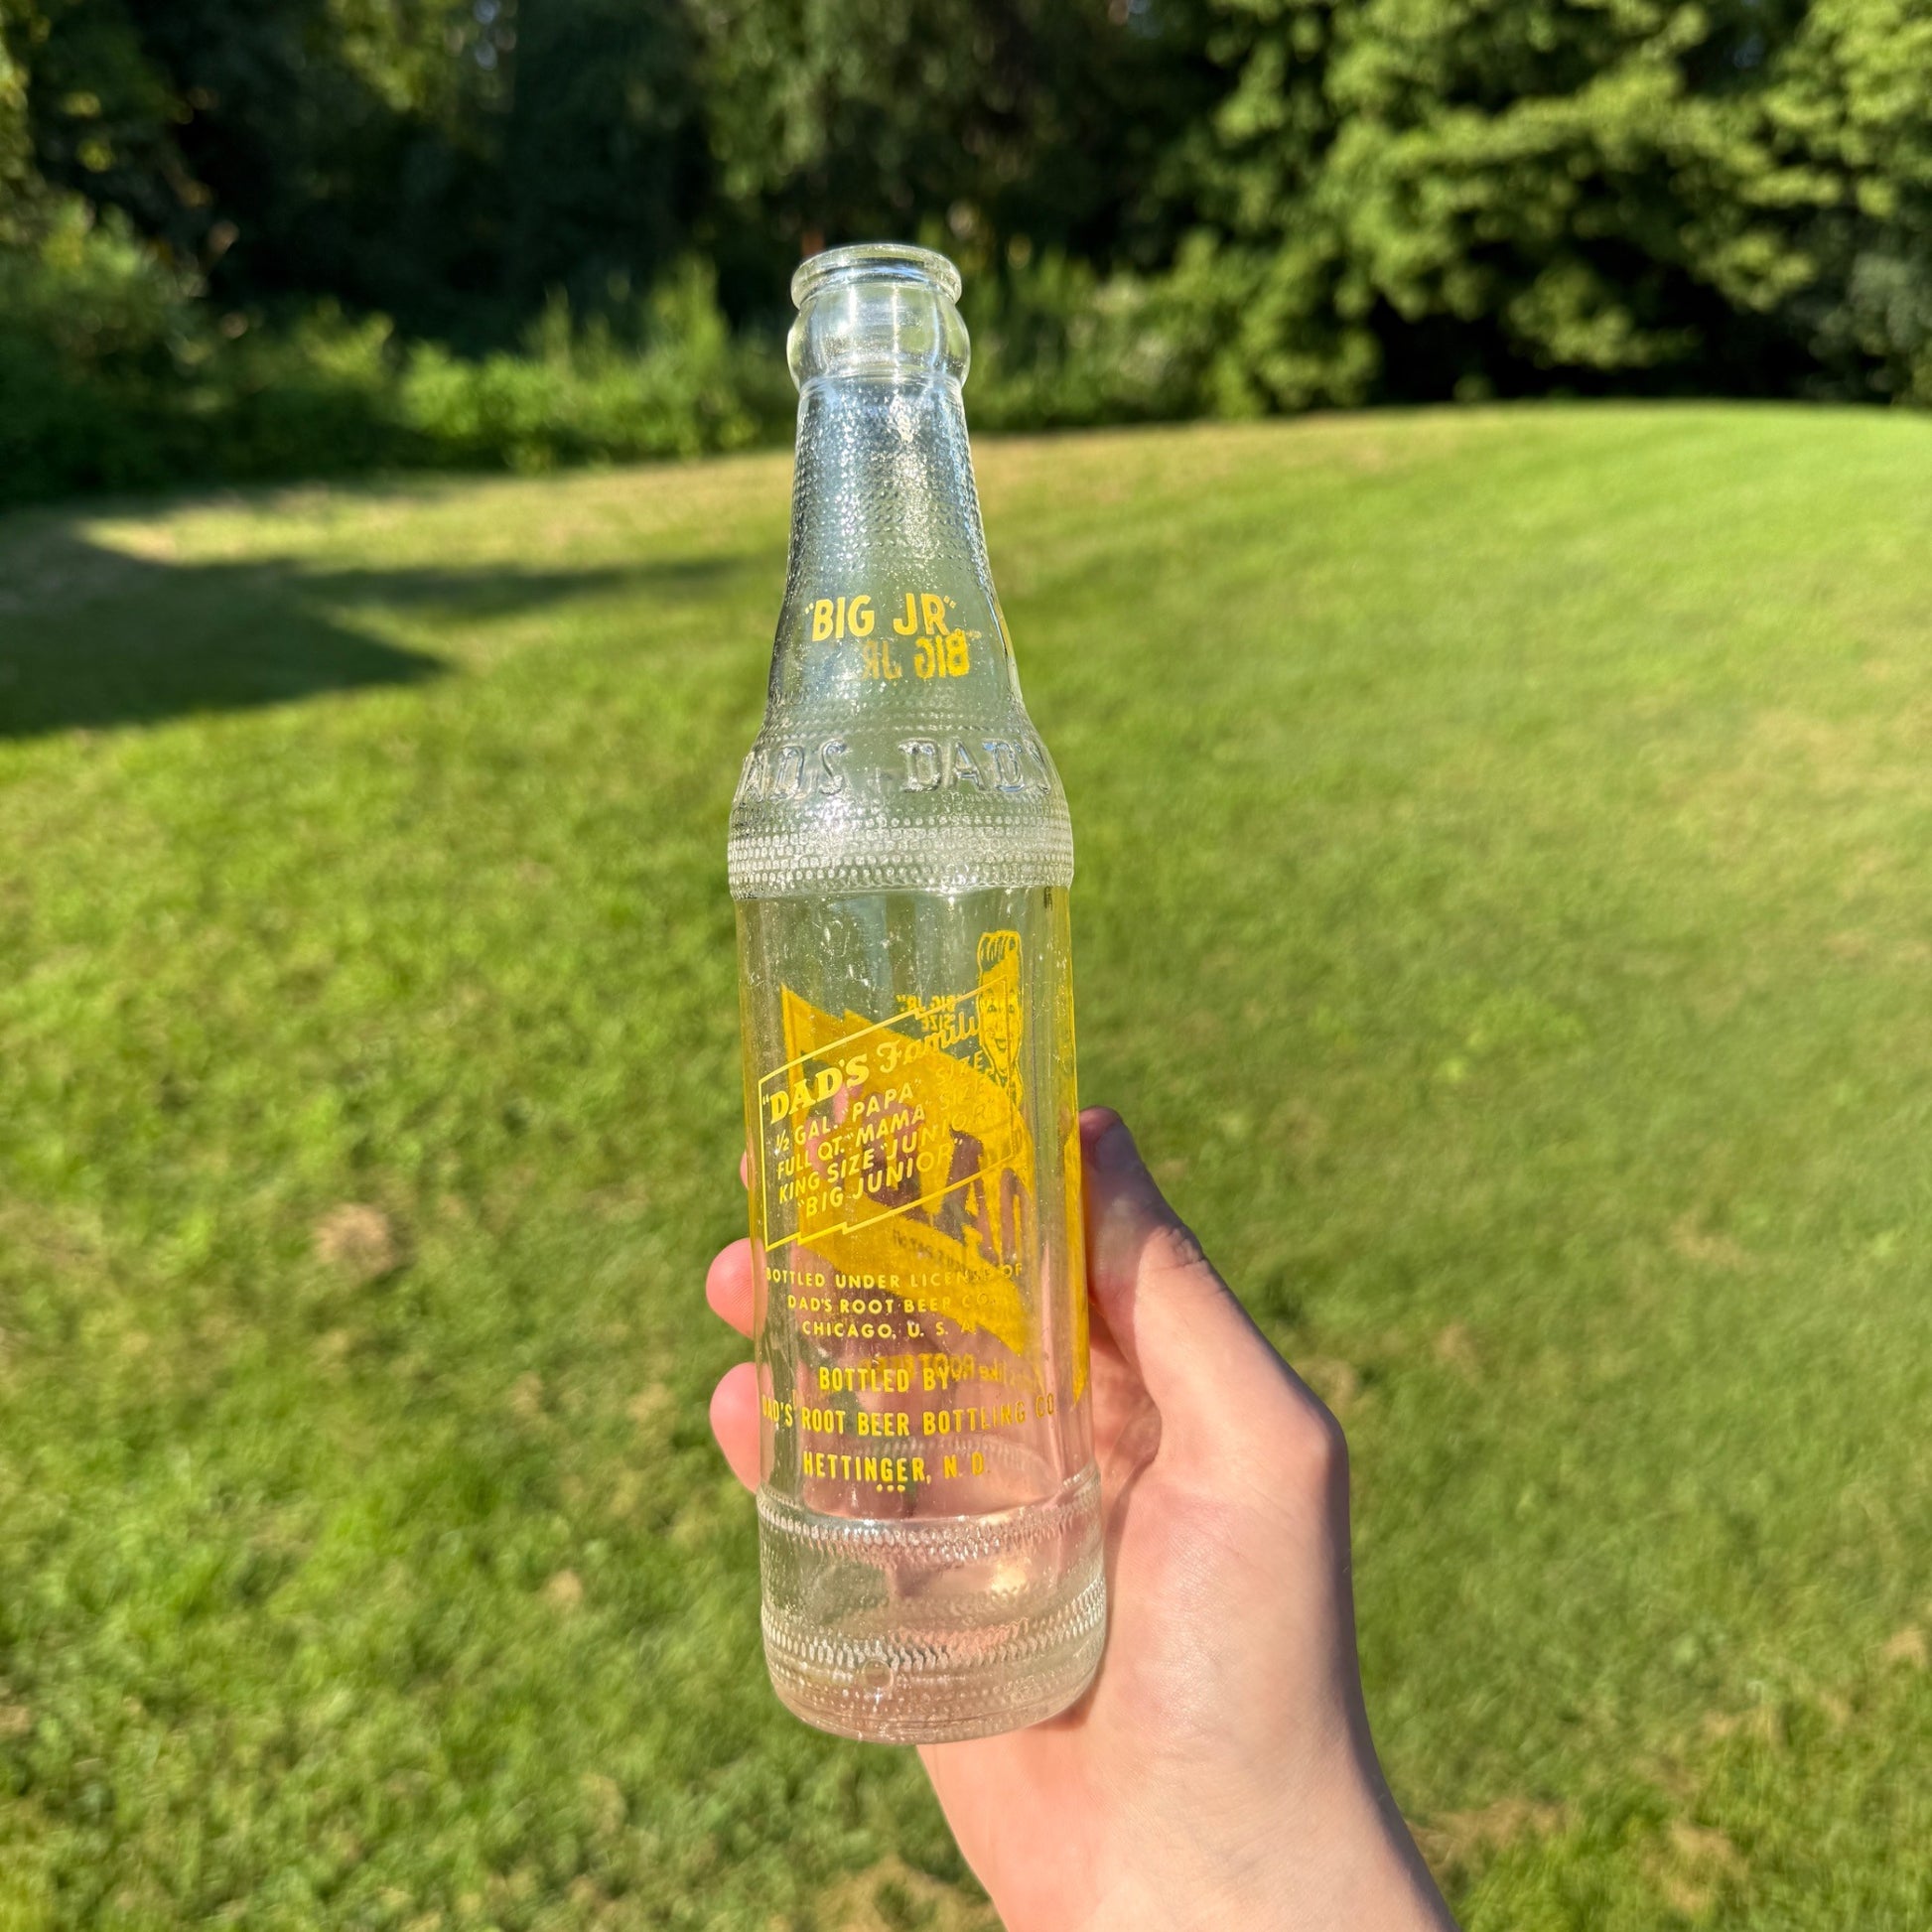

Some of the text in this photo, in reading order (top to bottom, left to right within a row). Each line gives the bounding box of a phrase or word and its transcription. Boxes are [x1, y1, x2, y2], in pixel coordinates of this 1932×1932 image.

[804, 595, 875, 642] "BIG
[794, 1115, 839, 1146] GAL.
[777, 1149, 812, 1180] FULL
[817, 1136, 846, 1162] QT.
[778, 1171, 820, 1205] KING
[827, 1147, 875, 1183] SIZE
[765, 1267, 826, 1288] BOTTLED
[835, 1274, 901, 1290] UNDER
[786, 1294, 833, 1313] DAD'S
[839, 1299, 895, 1315] ROOT
[903, 1297, 952, 1314] BEER
[801, 1319, 897, 1340] CHICAGO,
[819, 1365, 910, 1394] BOTTLED
[922, 1366, 950, 1392] BY
[800, 1405, 847, 1436] ROOT
[857, 1411, 910, 1438] BEER
[922, 1400, 1026, 1437] BOTTLING
[802, 1450, 932, 1484] HETTINGER,
